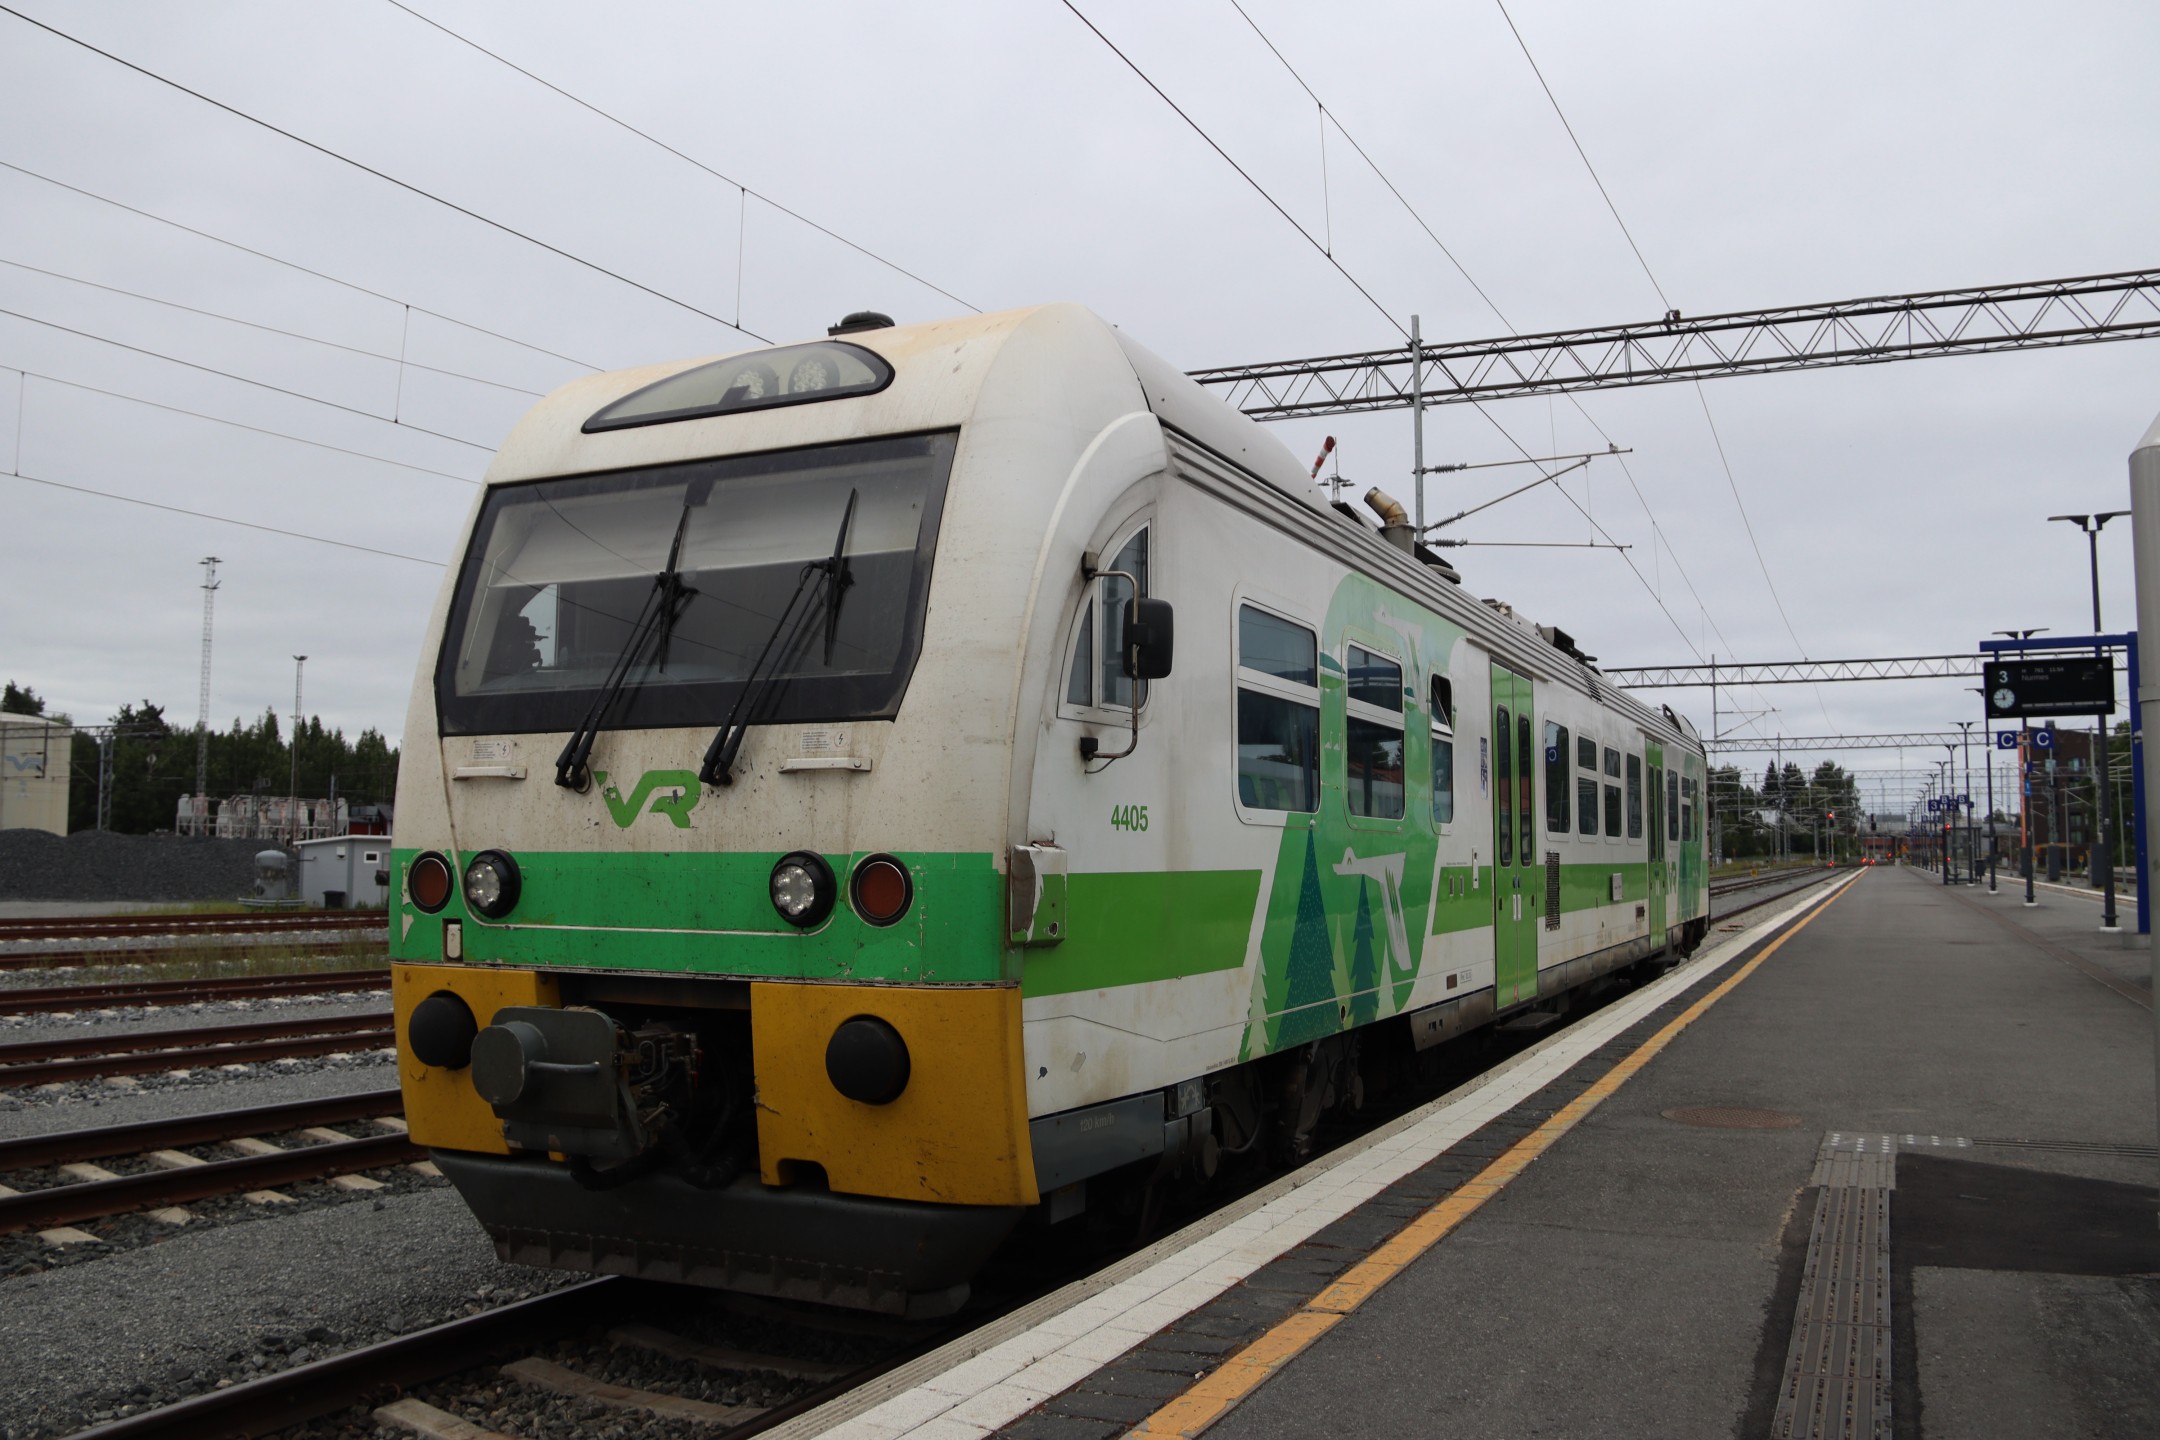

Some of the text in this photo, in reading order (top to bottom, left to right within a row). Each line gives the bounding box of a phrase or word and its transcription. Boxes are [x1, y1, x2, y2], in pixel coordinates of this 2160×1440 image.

[1999, 670, 2008, 683] 3
[2001, 733, 2014, 747] C
[2036, 732, 2050, 746] C
[593, 769, 702, 829] VR
[1930, 801, 1938, 810] 3
[1941, 796, 1948, 804] B
[1958, 795, 1966, 803] B
[1111, 804, 1149, 832] 4405
[1080, 1112, 1115, 1133] 120 km/h
